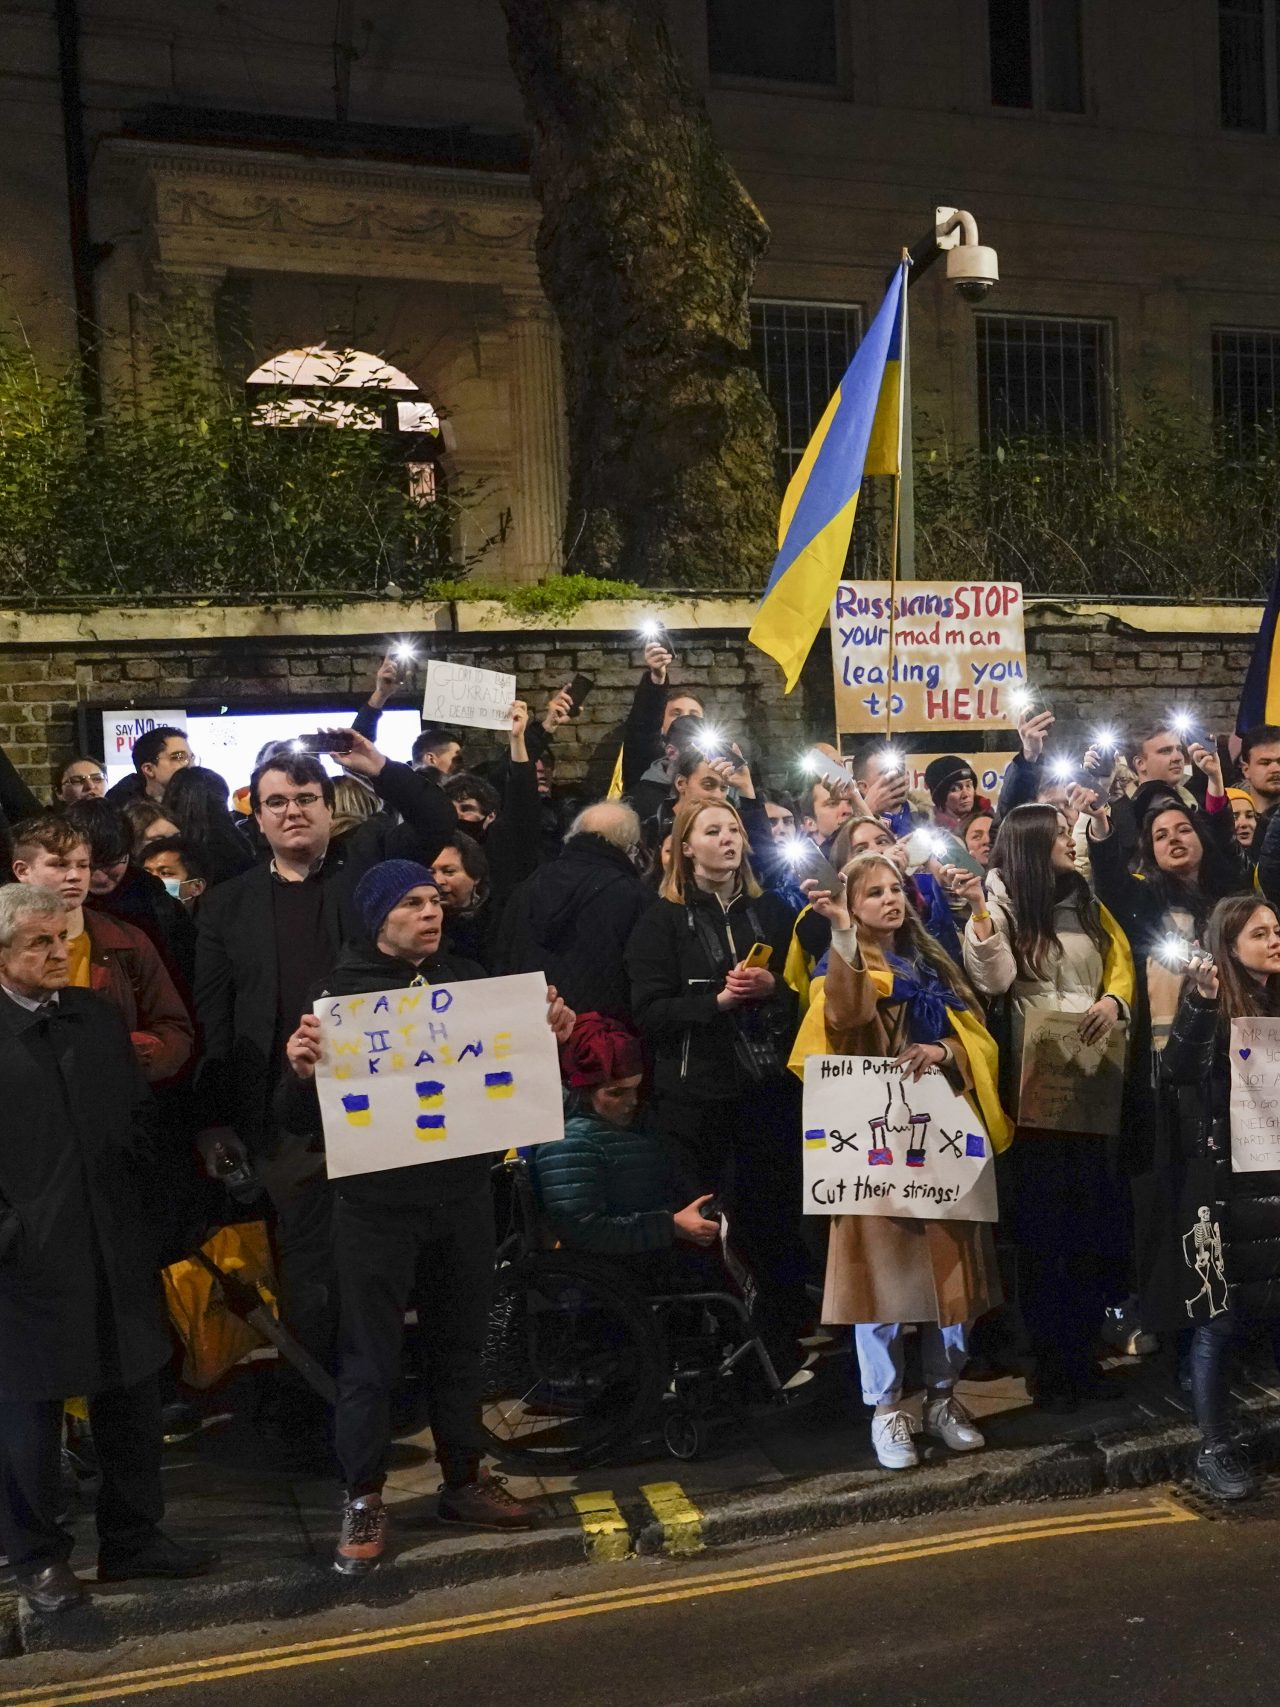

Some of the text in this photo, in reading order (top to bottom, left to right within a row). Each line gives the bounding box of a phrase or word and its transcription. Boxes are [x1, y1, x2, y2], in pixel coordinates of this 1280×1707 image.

[836, 586, 1018, 620] Russians STOP
[838, 625, 889, 648] your
[843, 655, 1023, 689] leading you
[452, 682, 513, 705] UKRAINE
[863, 692, 904, 716] to
[115, 724, 134, 736] SAY
[330, 989, 453, 1026] STAND
[1241, 1029, 1262, 1041] MR
[821, 1060, 853, 1078] Hold
[1239, 1072, 1265, 1086] NOT
[1240, 1099, 1256, 1109] TO
[1260, 1099, 1278, 1109] GO
[1233, 1134, 1264, 1146] YARD
[1250, 1153, 1270, 1162] NOT
[811, 1175, 960, 1205] Cut their strings!
